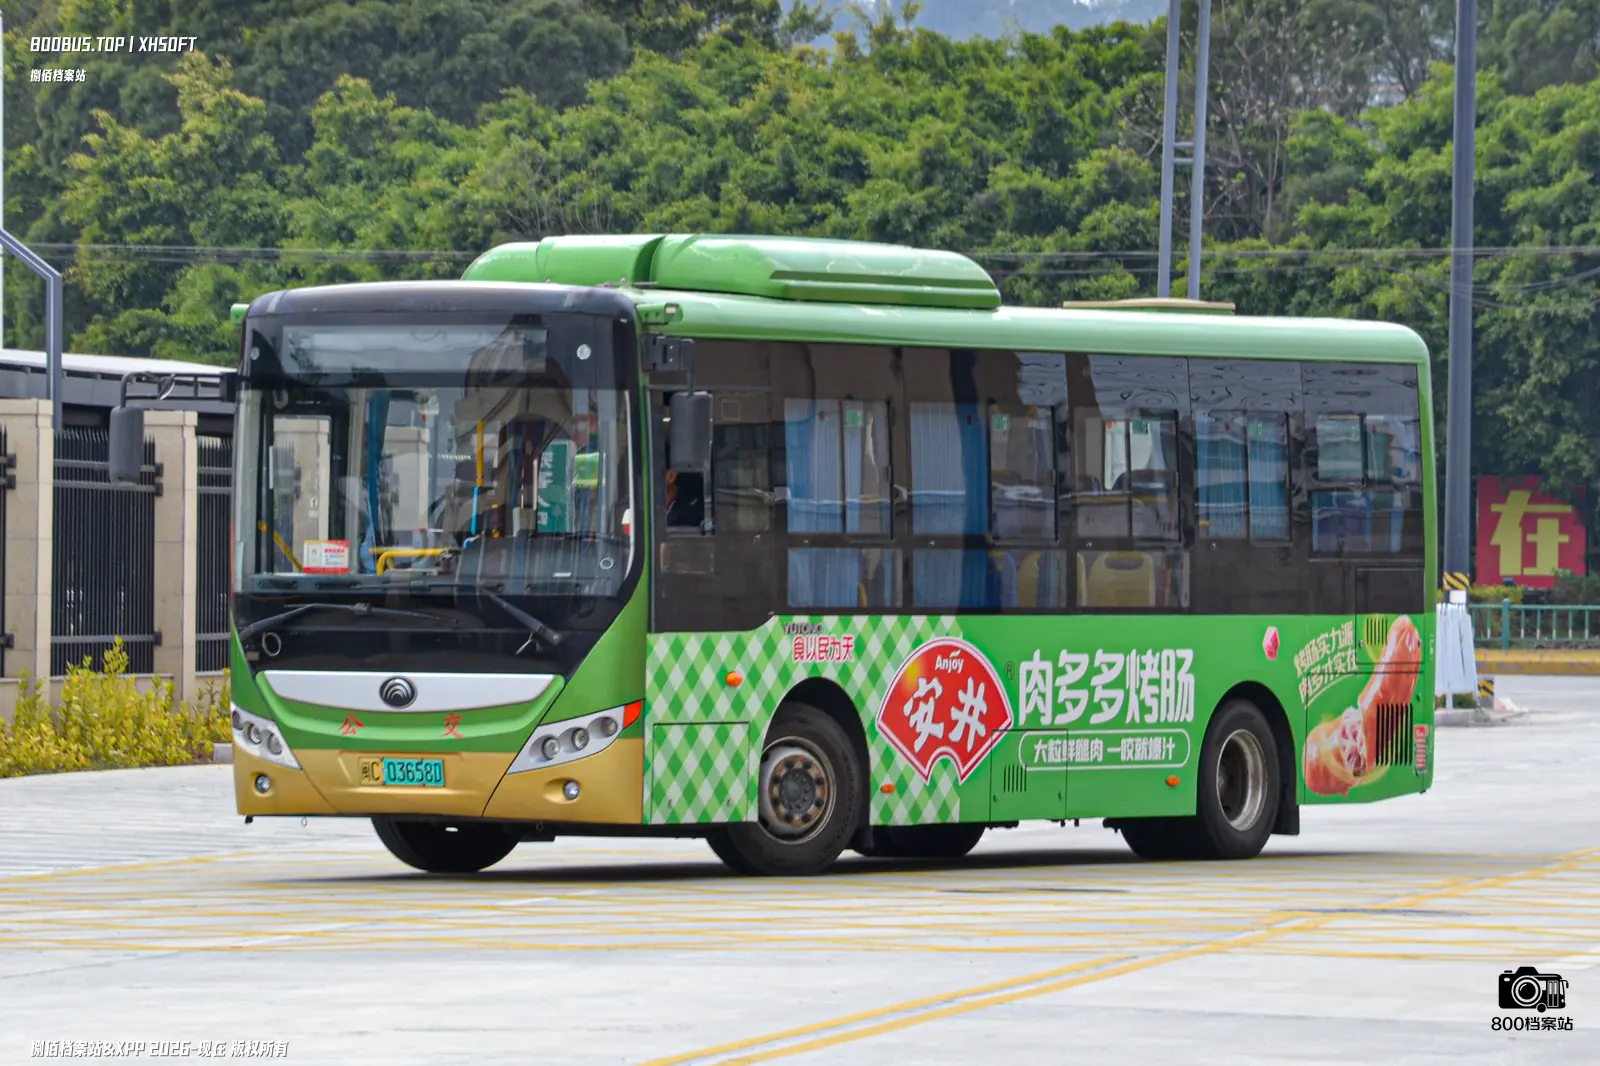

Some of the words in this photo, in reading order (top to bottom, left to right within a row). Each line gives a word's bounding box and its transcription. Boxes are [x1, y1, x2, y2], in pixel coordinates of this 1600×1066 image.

[1490, 490, 1572, 576] 在
[792, 634, 855, 662] 食以民为天
[935, 651, 964, 674] Anjoy
[1018, 648, 1196, 726] 肉多多烤肠
[339, 712, 365, 736] 公
[440, 713, 464, 739] 交
[903, 676, 987, 753] 安井
